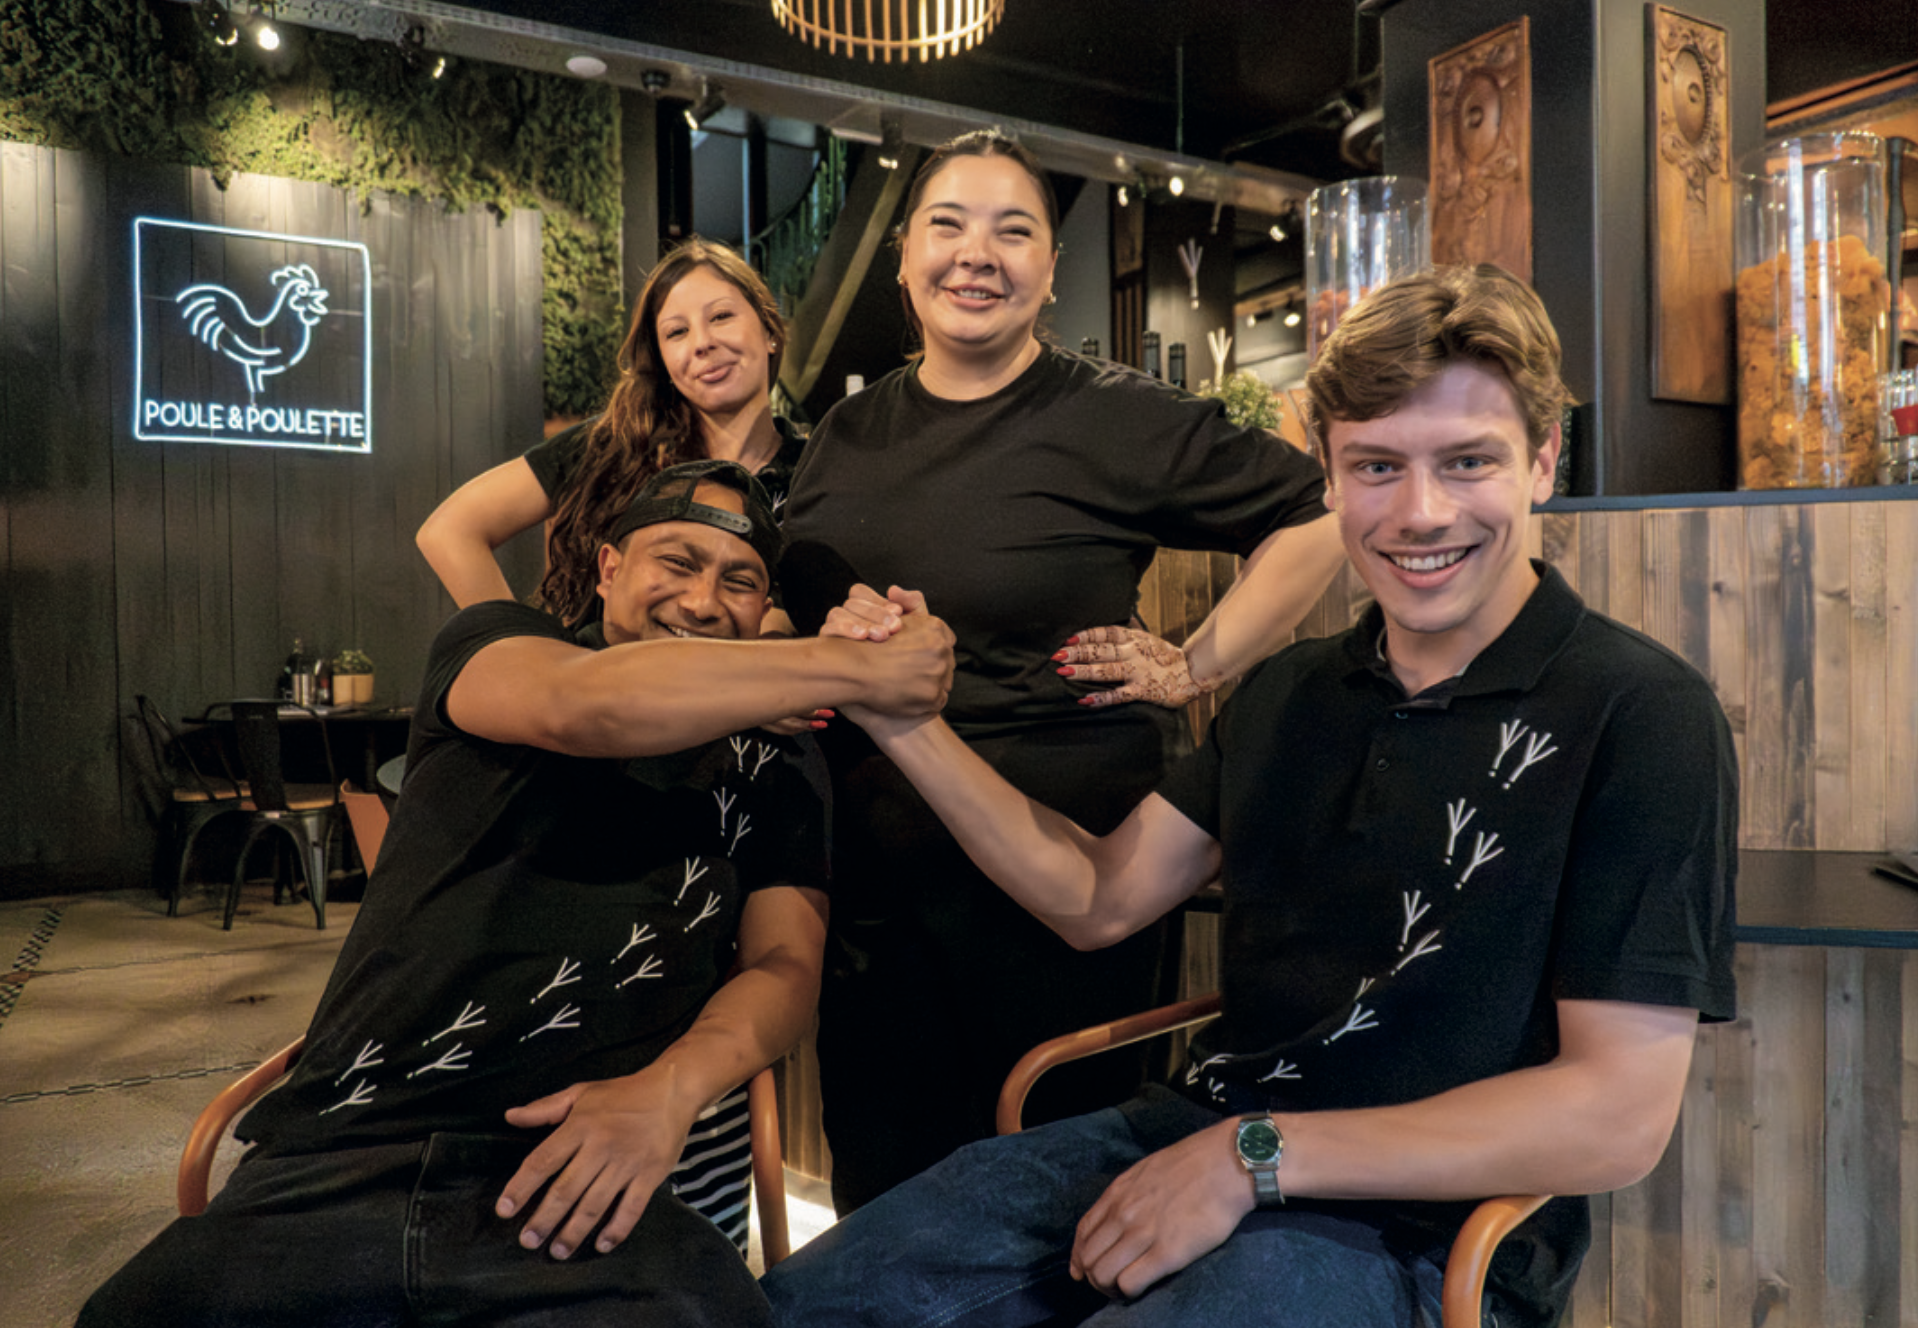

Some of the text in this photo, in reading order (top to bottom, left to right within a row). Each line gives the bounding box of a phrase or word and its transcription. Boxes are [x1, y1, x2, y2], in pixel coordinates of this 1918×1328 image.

[145, 400, 364, 437] POULE & POULETTE
